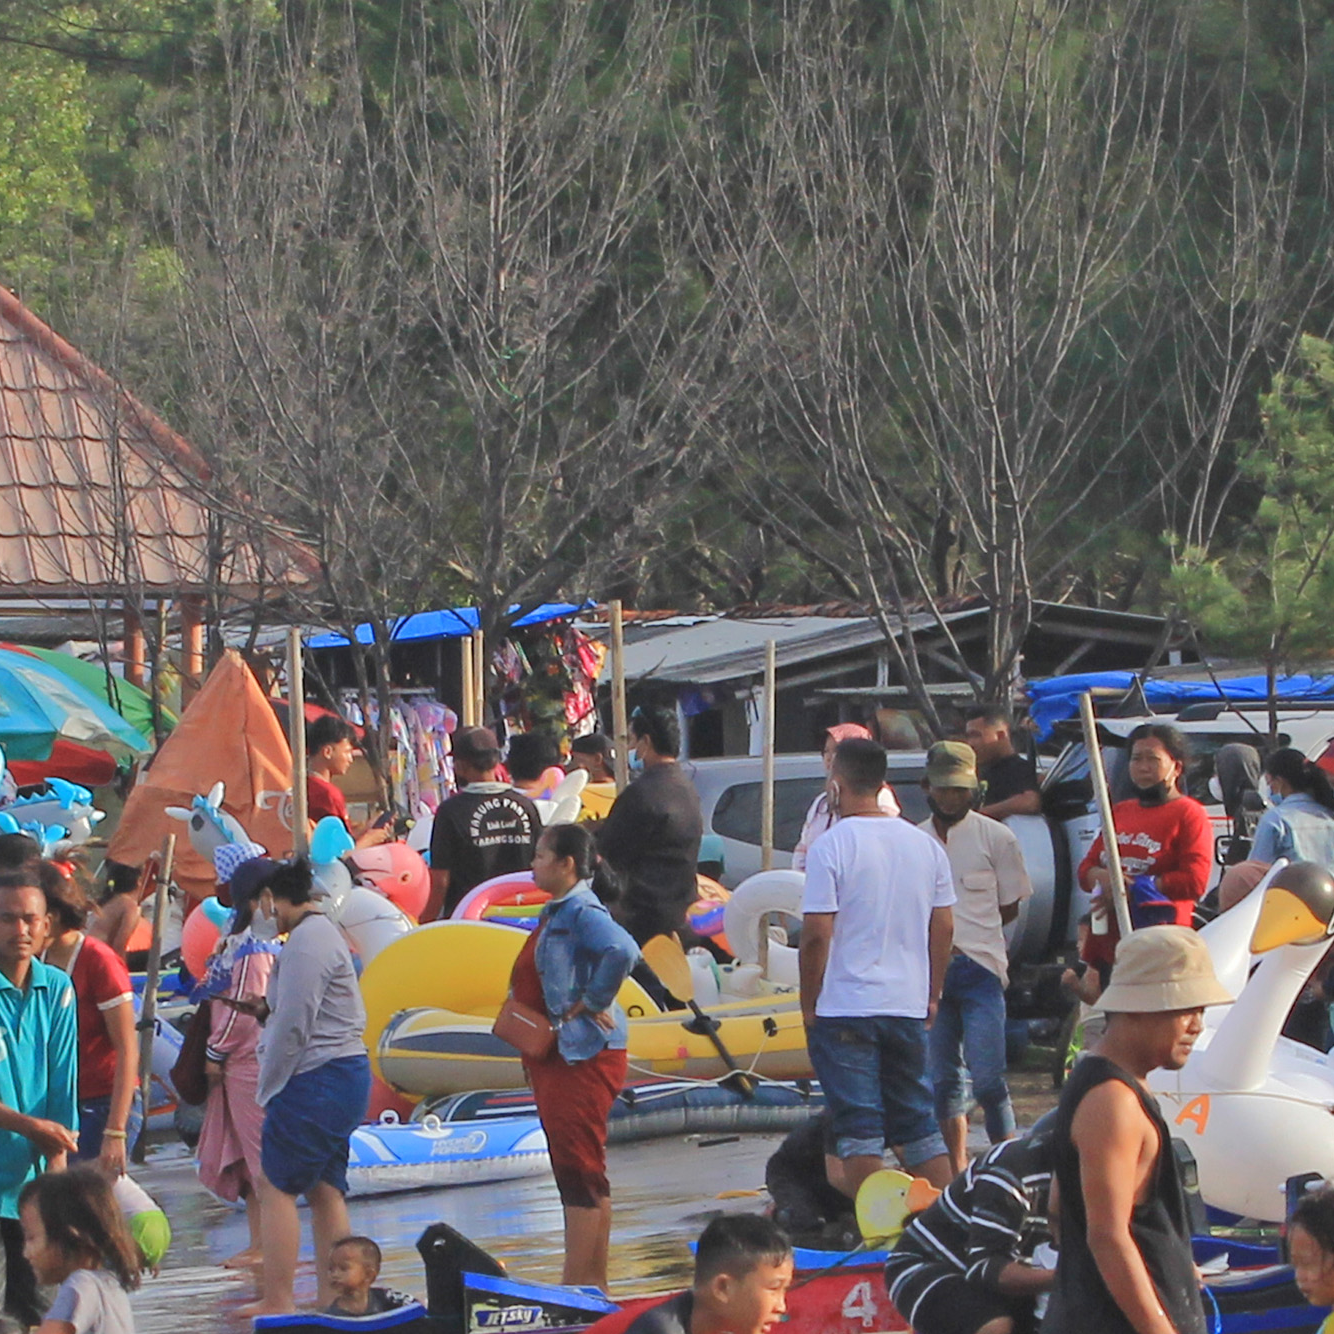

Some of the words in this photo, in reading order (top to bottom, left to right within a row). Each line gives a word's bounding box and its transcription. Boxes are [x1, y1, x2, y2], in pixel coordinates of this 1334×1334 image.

[470, 798, 501, 837] WARUNG
[1174, 1094, 1210, 1135] A
[842, 1282, 877, 1327] 4
